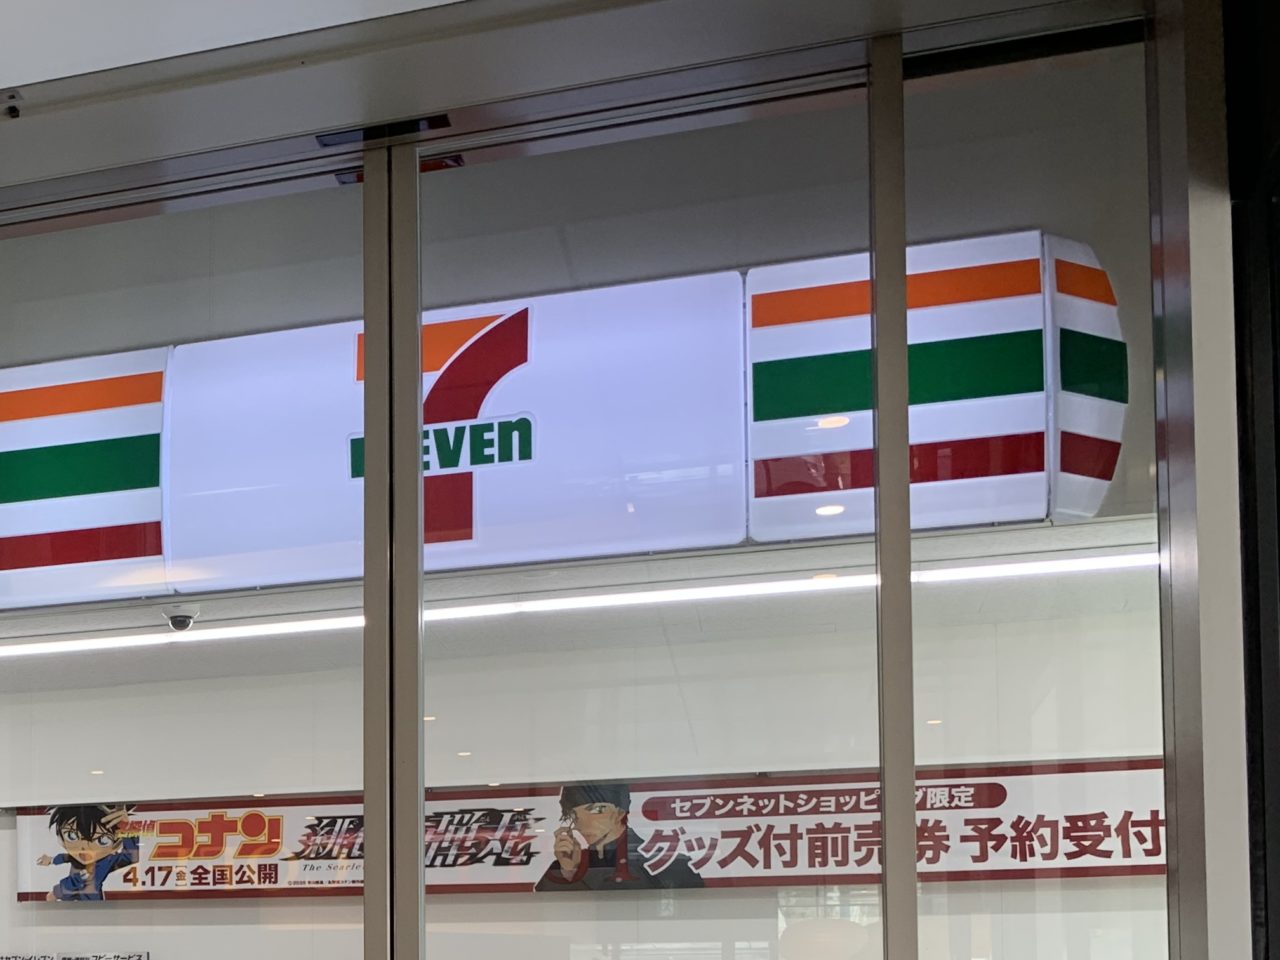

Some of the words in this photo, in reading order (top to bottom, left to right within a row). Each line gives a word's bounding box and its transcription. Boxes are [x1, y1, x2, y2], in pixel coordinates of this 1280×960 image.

[671, 786, 975, 817] セブンネットショッピ限定
[148, 809, 283, 861] コナン
[325, 862, 364, 872] Scarle
